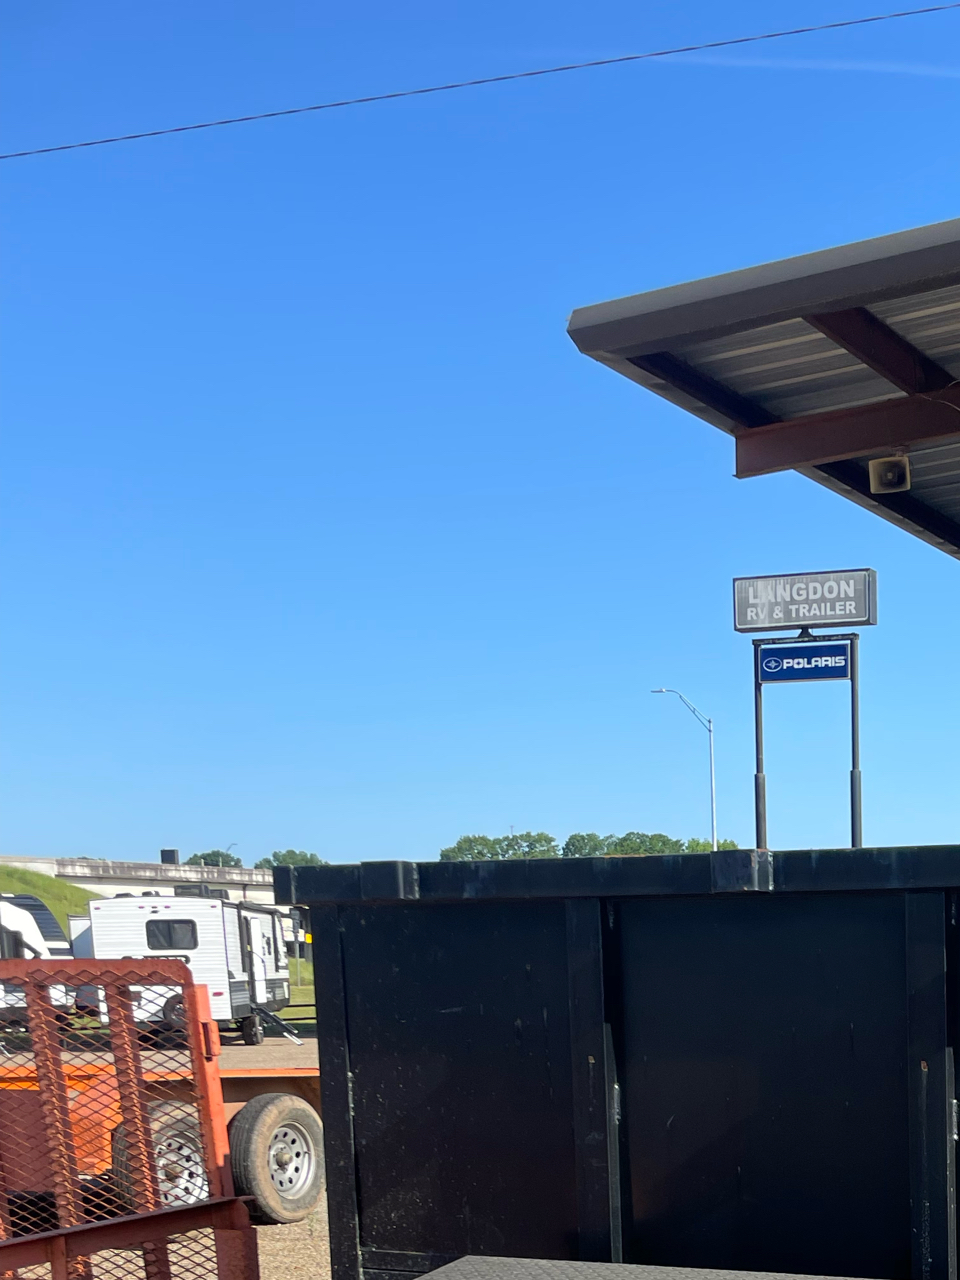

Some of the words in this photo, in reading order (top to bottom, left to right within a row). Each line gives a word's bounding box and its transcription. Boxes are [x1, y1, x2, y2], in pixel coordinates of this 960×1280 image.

[748, 579, 855, 604] LANGDON
[746, 607, 767, 621] RV
[772, 605, 784, 619] &
[788, 601, 857, 618] TRAILER
[782, 655, 846, 670] POLARIS
